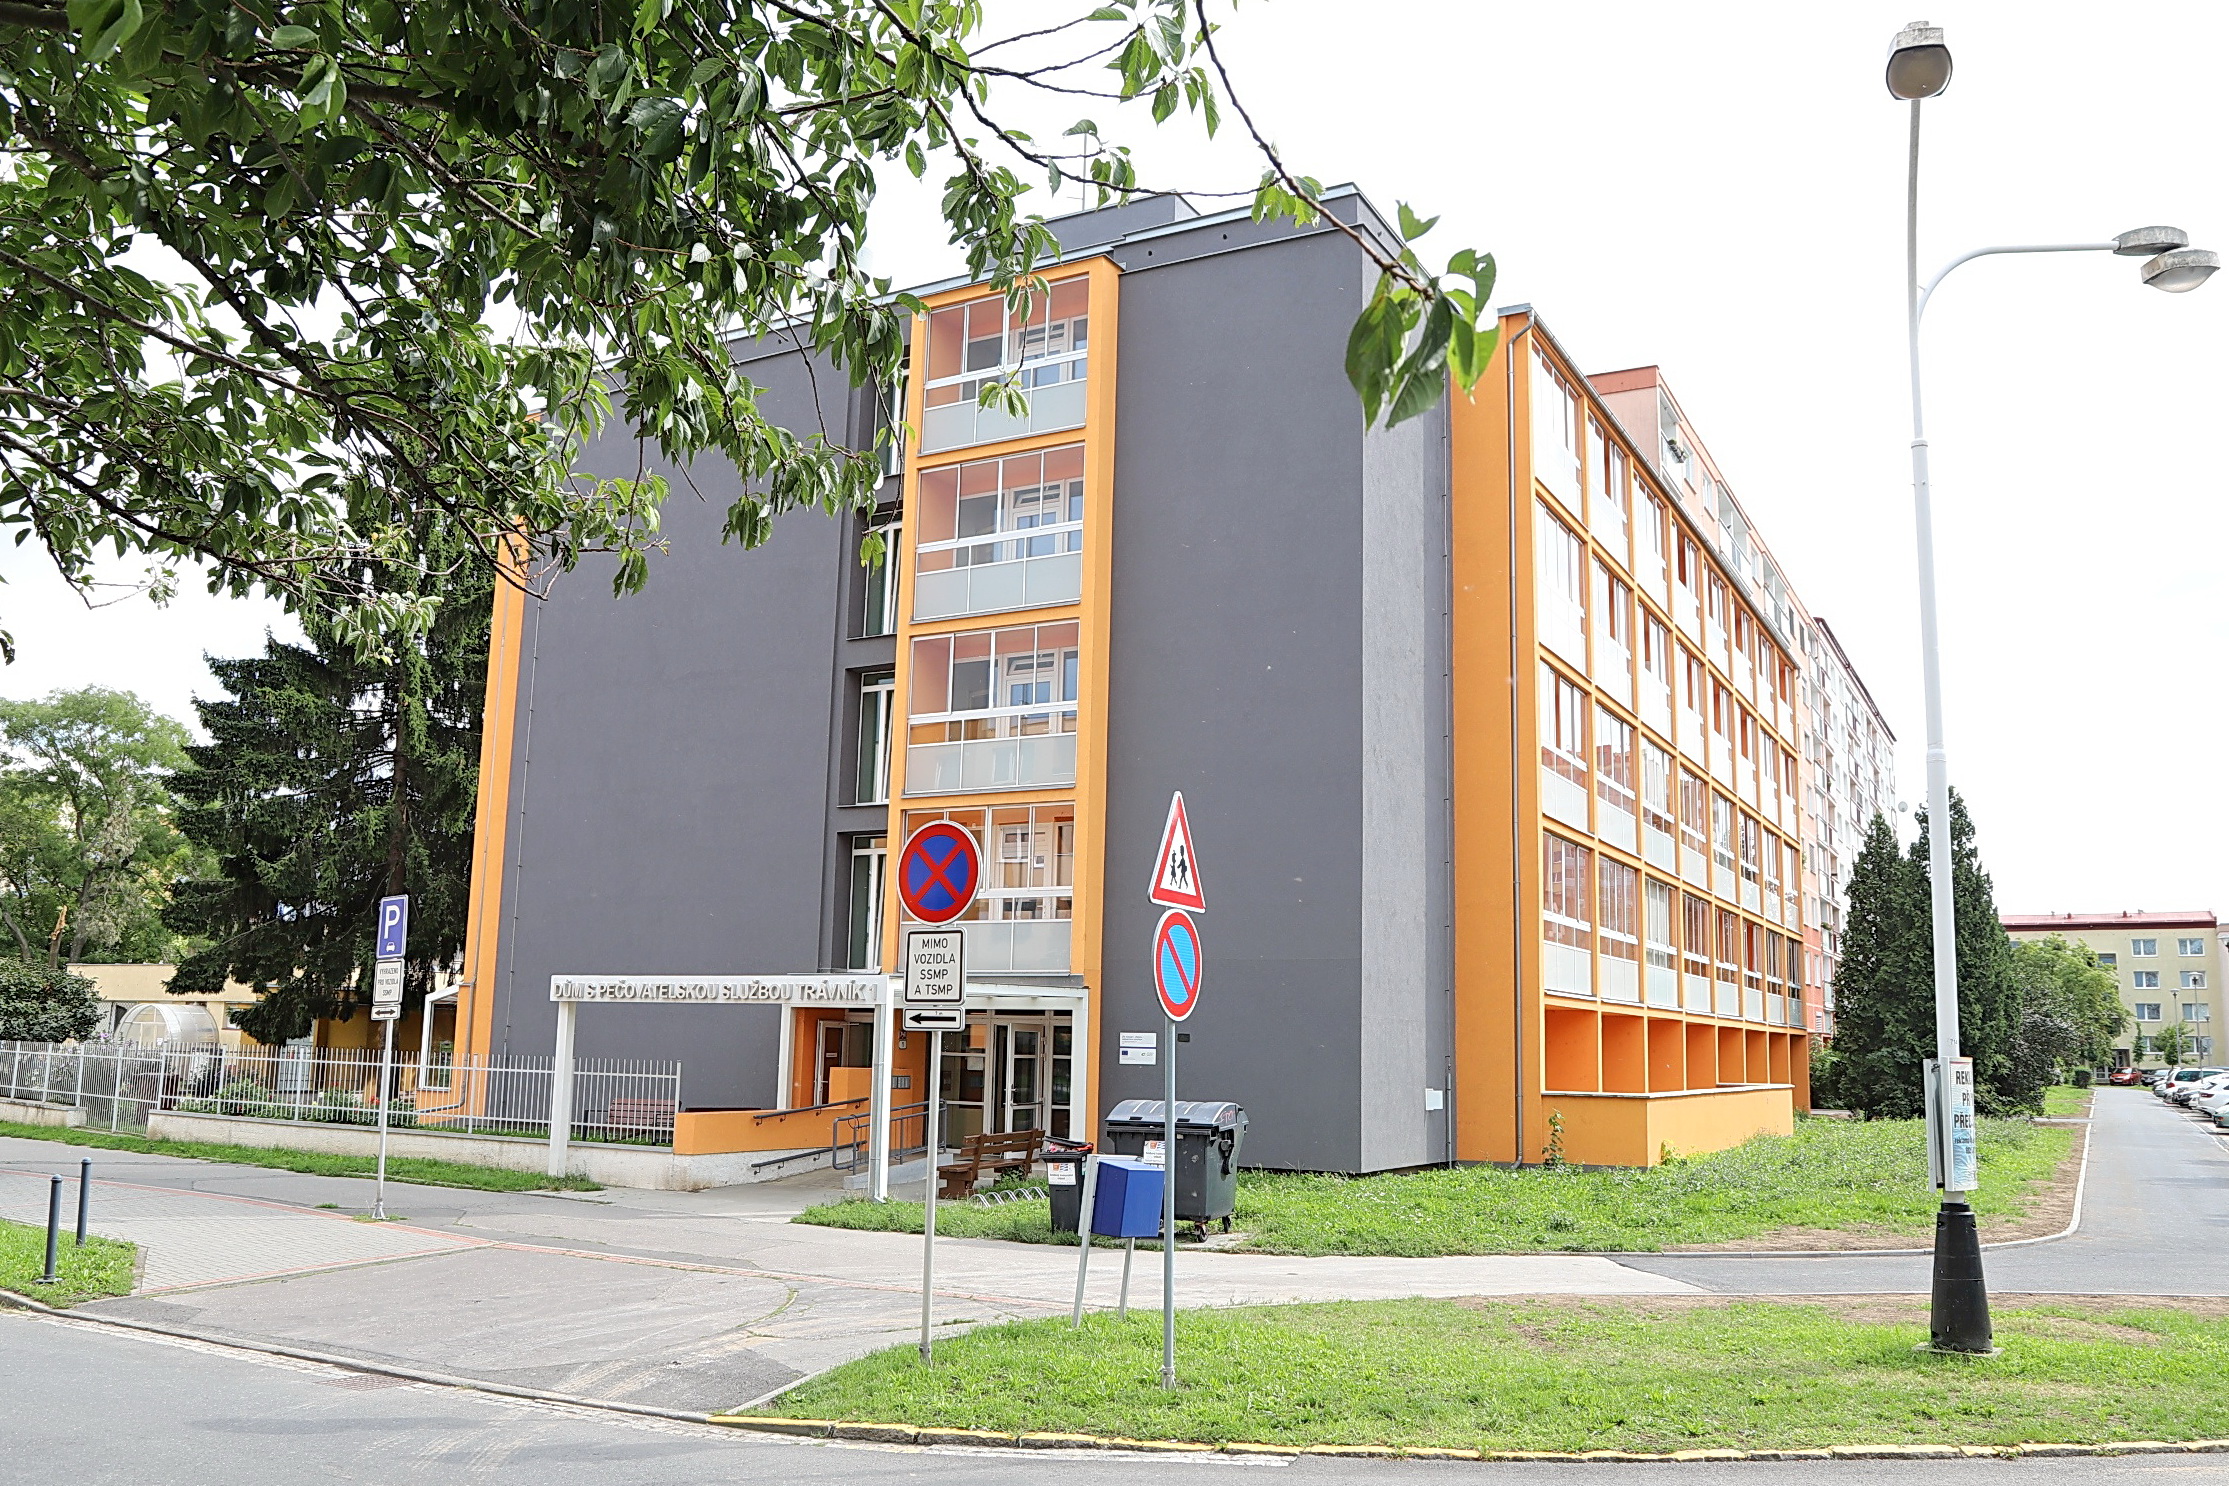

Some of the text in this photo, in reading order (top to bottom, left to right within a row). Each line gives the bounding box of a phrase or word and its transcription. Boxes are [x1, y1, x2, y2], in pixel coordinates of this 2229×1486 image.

[383, 904, 401, 940] P
[921, 938, 949, 950] MIMO
[913, 953, 956, 965] VOZIDLA
[919, 968, 949, 980] SSMP
[554, 979, 878, 1001] DŮM S PEČOVATELSKOU SLUŽBOU TRÁVNÍK 1
[914, 984, 954, 996] A TSMP
